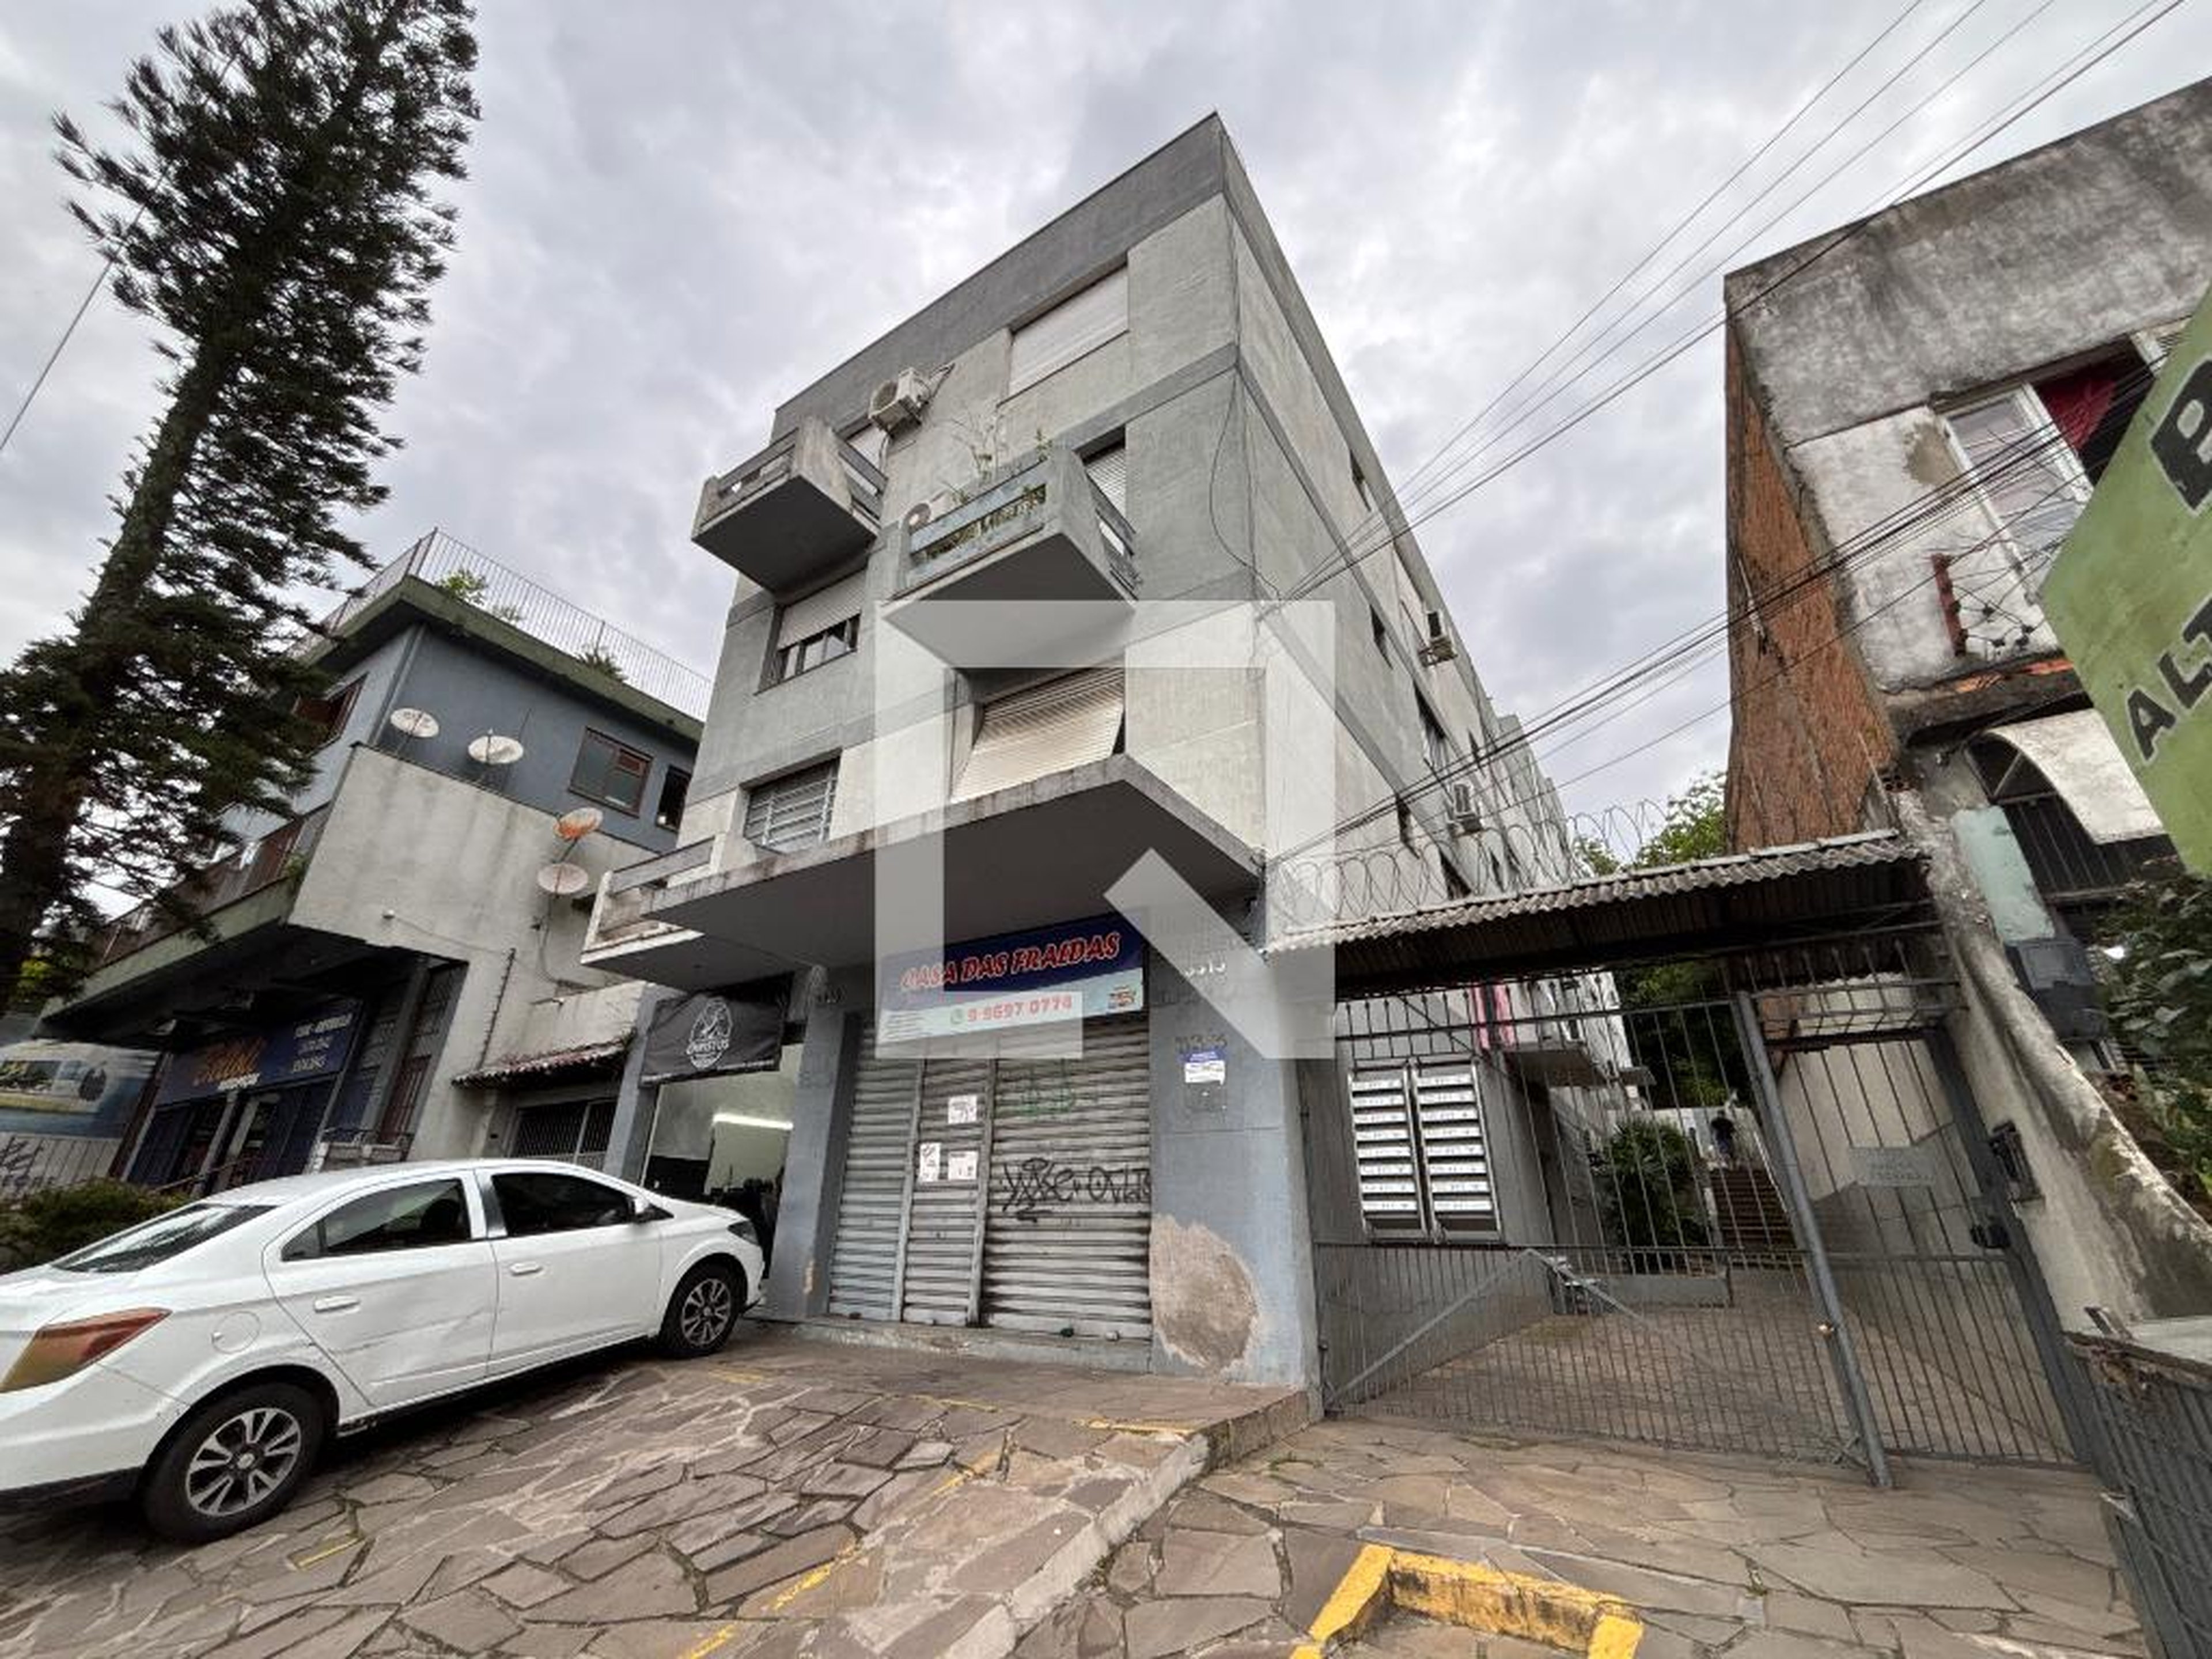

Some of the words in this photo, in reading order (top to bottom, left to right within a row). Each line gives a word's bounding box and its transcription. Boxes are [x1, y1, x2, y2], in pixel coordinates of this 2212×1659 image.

[900, 961, 958, 992] CASA
[961, 953, 1009, 982] DAS
[1010, 932, 1121, 975] FRALDAS
